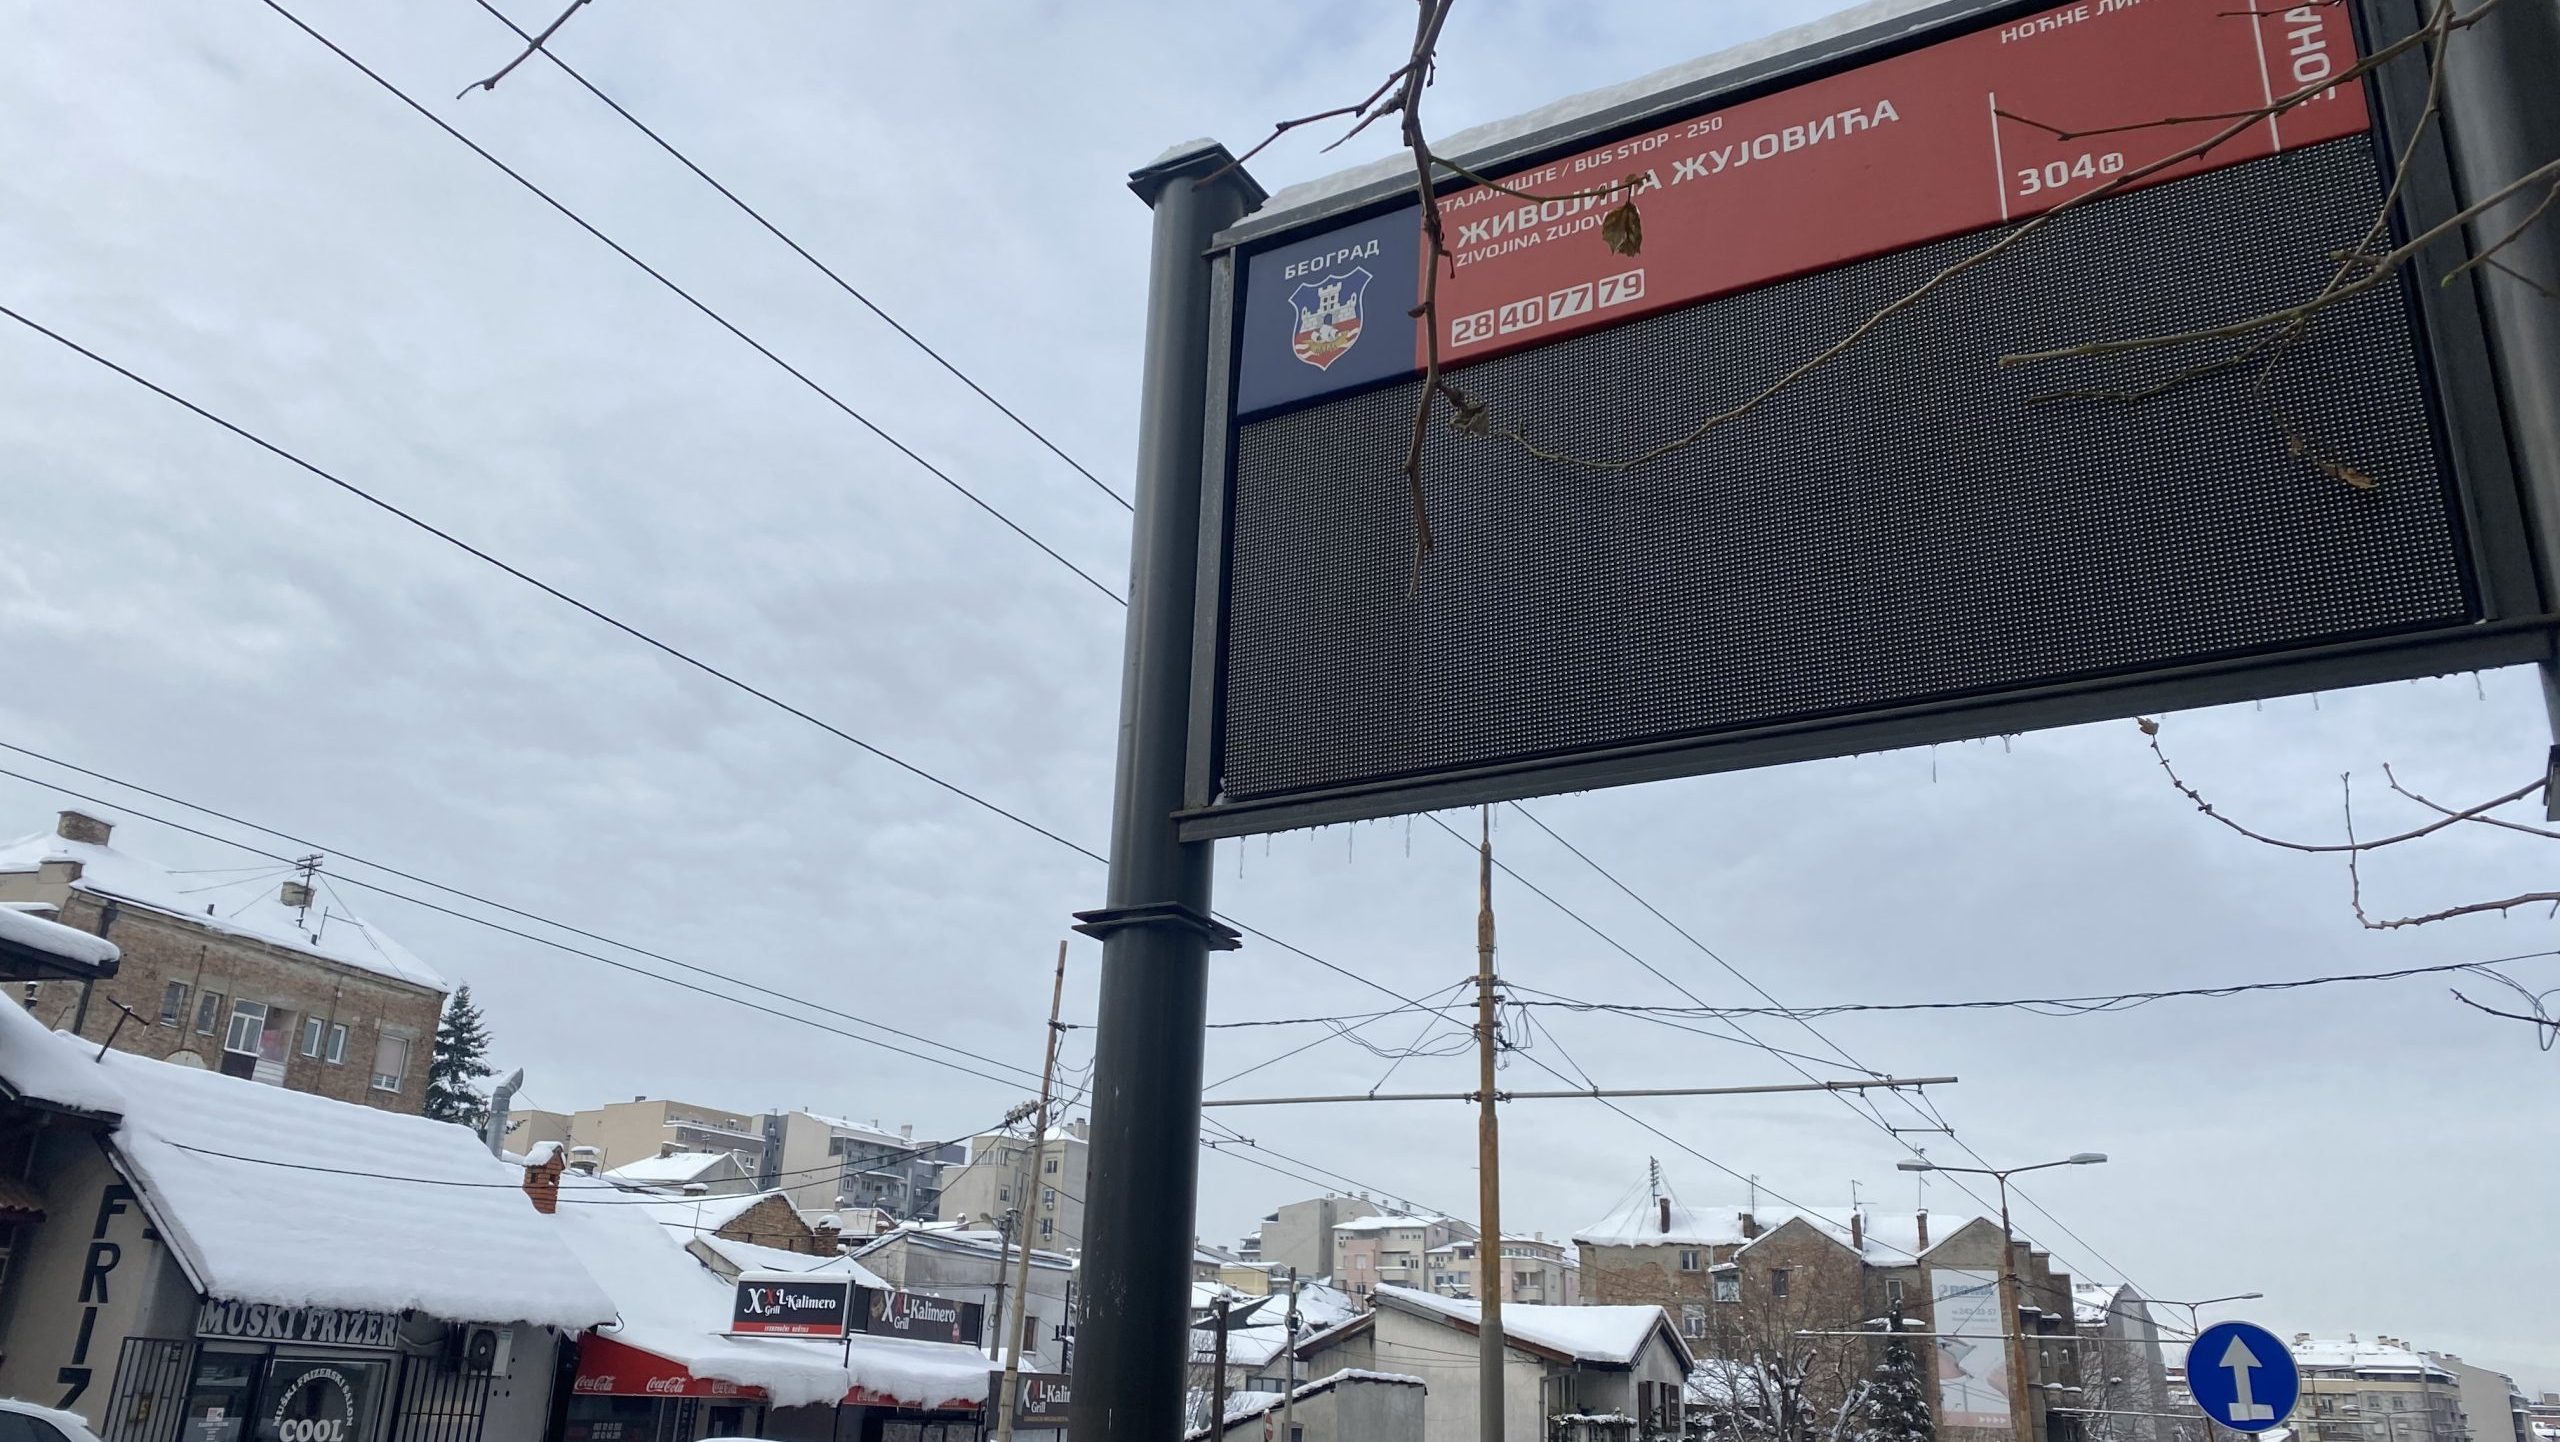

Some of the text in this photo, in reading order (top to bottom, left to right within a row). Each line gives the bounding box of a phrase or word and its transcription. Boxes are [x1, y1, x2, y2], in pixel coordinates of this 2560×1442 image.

[2000, 5, 2090, 44] НОЋНЕ
[1574, 150, 1613, 173] BUS
[1617, 133, 1669, 160] STOP
[1687, 116, 1723, 140] 250
[1456, 99, 1900, 249] ЖИВОЈИНА ЖУЈОВИЋА
[1284, 238, 1381, 280] БЕОГРАД
[1456, 231, 1541, 267] ZIVOJINA
[1453, 272, 1642, 344] 28 40 77 79
[764, 1305, 781, 1317] Grill
[786, 1294, 836, 1311] Kalimero
[910, 1299, 956, 1323] Kalimero
[301, 1307, 397, 1347] FRIZER
[893, 1315, 910, 1330] Grill
[296, 1368, 346, 1388] FRIZERSKI
[342, 1384, 354, 1427] SALON
[1030, 1401, 1047, 1413] Grill
[279, 1418, 344, 1442] COOL
